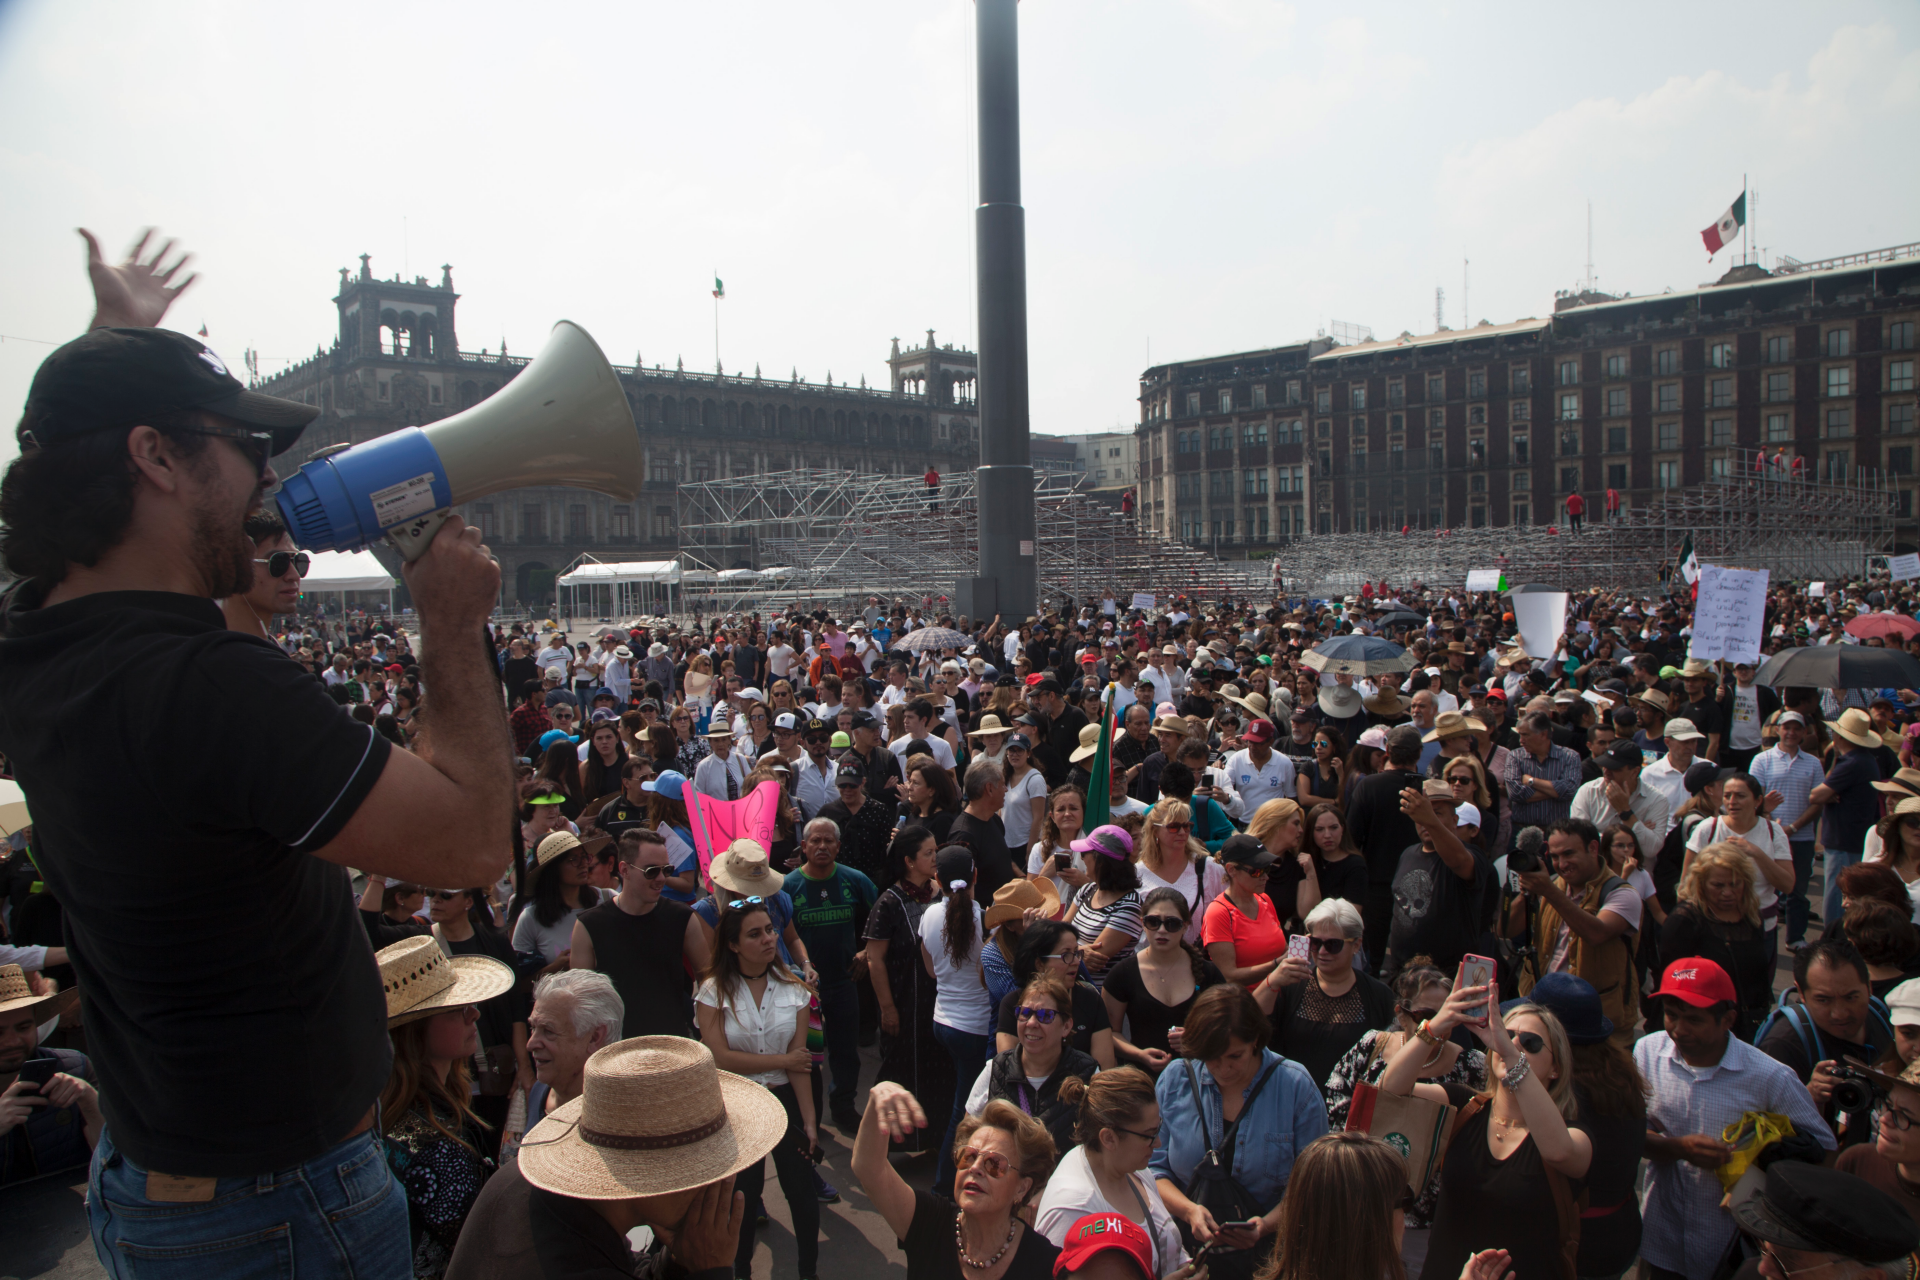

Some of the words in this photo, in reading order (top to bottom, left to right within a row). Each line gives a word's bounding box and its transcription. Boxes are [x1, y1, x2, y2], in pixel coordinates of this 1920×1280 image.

[411, 518, 430, 537] OK
[1716, 603, 1741, 613] unido
[801, 907, 852, 924] SORIANA
[1676, 971, 1697, 981] NIKE
